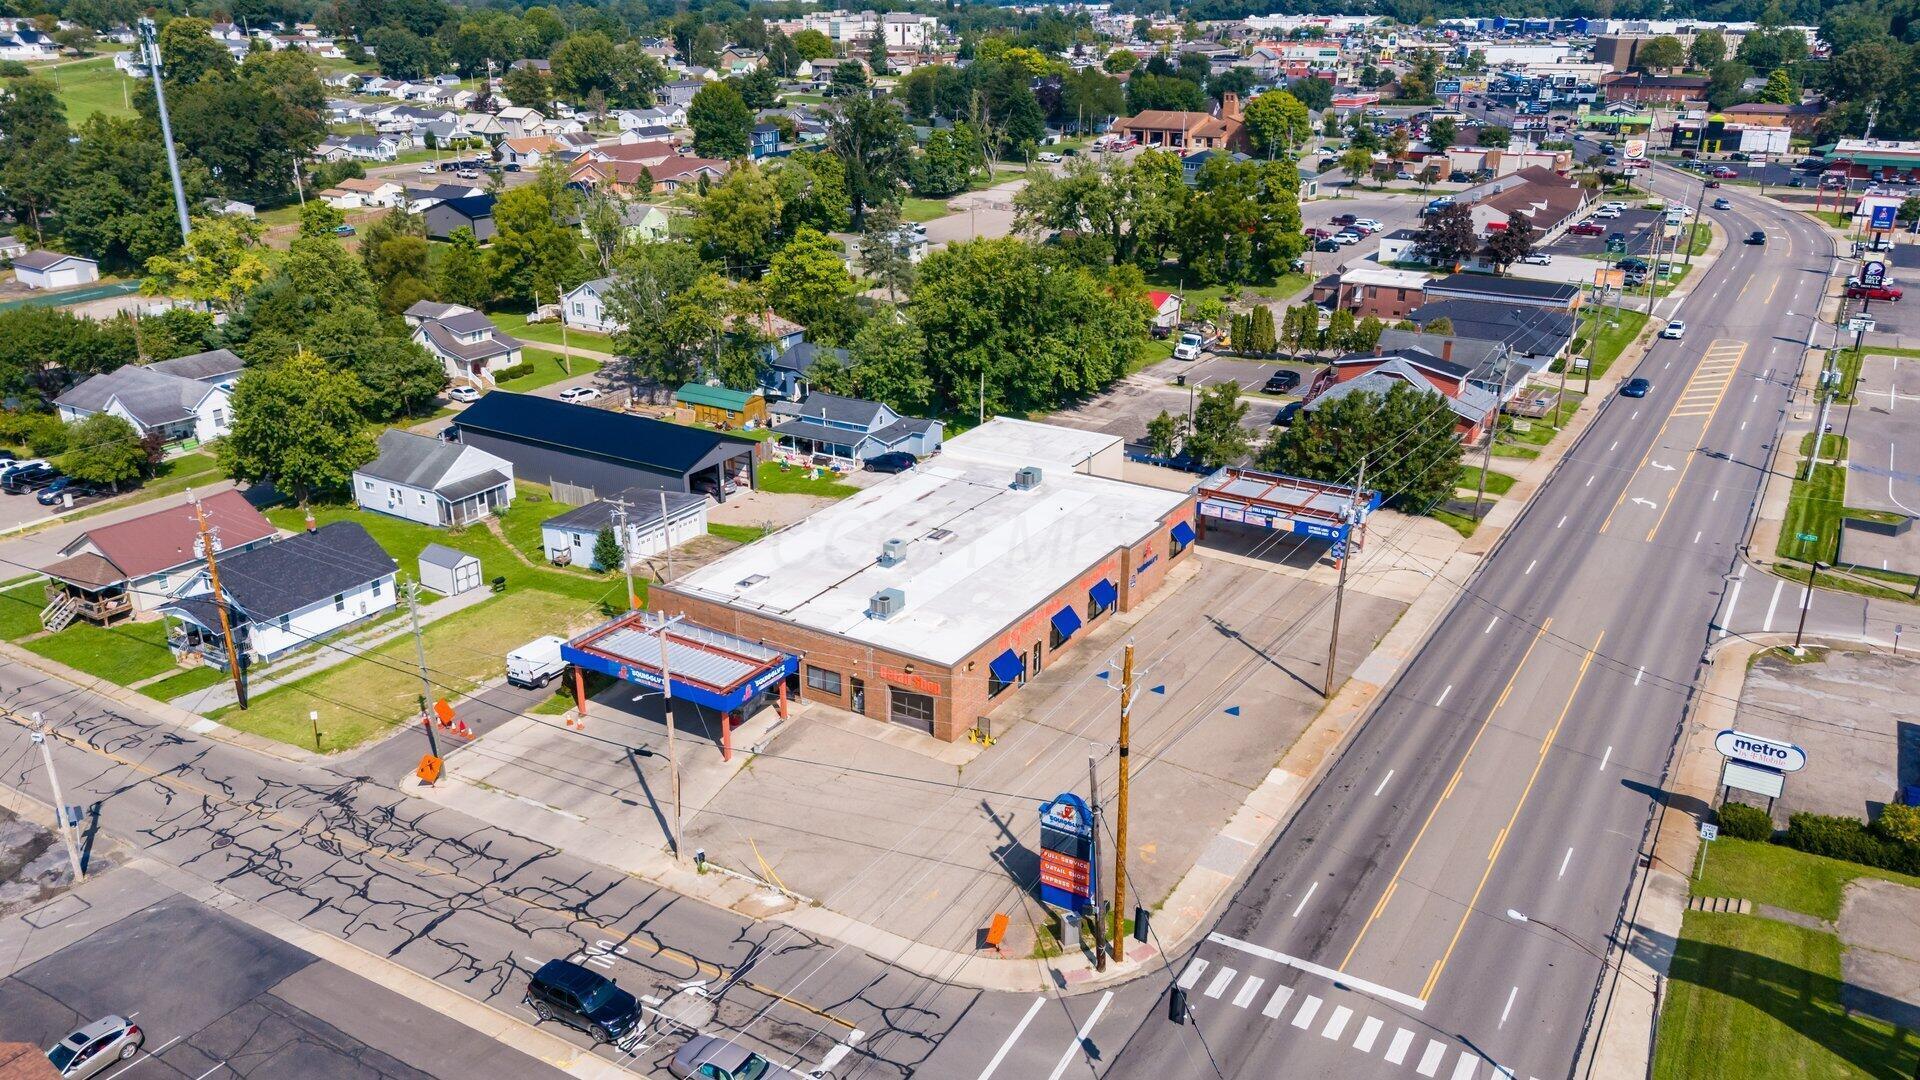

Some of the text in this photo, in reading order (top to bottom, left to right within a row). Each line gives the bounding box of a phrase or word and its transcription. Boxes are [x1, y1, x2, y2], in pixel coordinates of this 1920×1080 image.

[1735, 739, 1788, 758] metro
[1702, 830, 1714, 839] 35
[1044, 851, 1088, 869] FULL SERVICE
[1045, 863, 1086, 880] DETAIL SHOP
